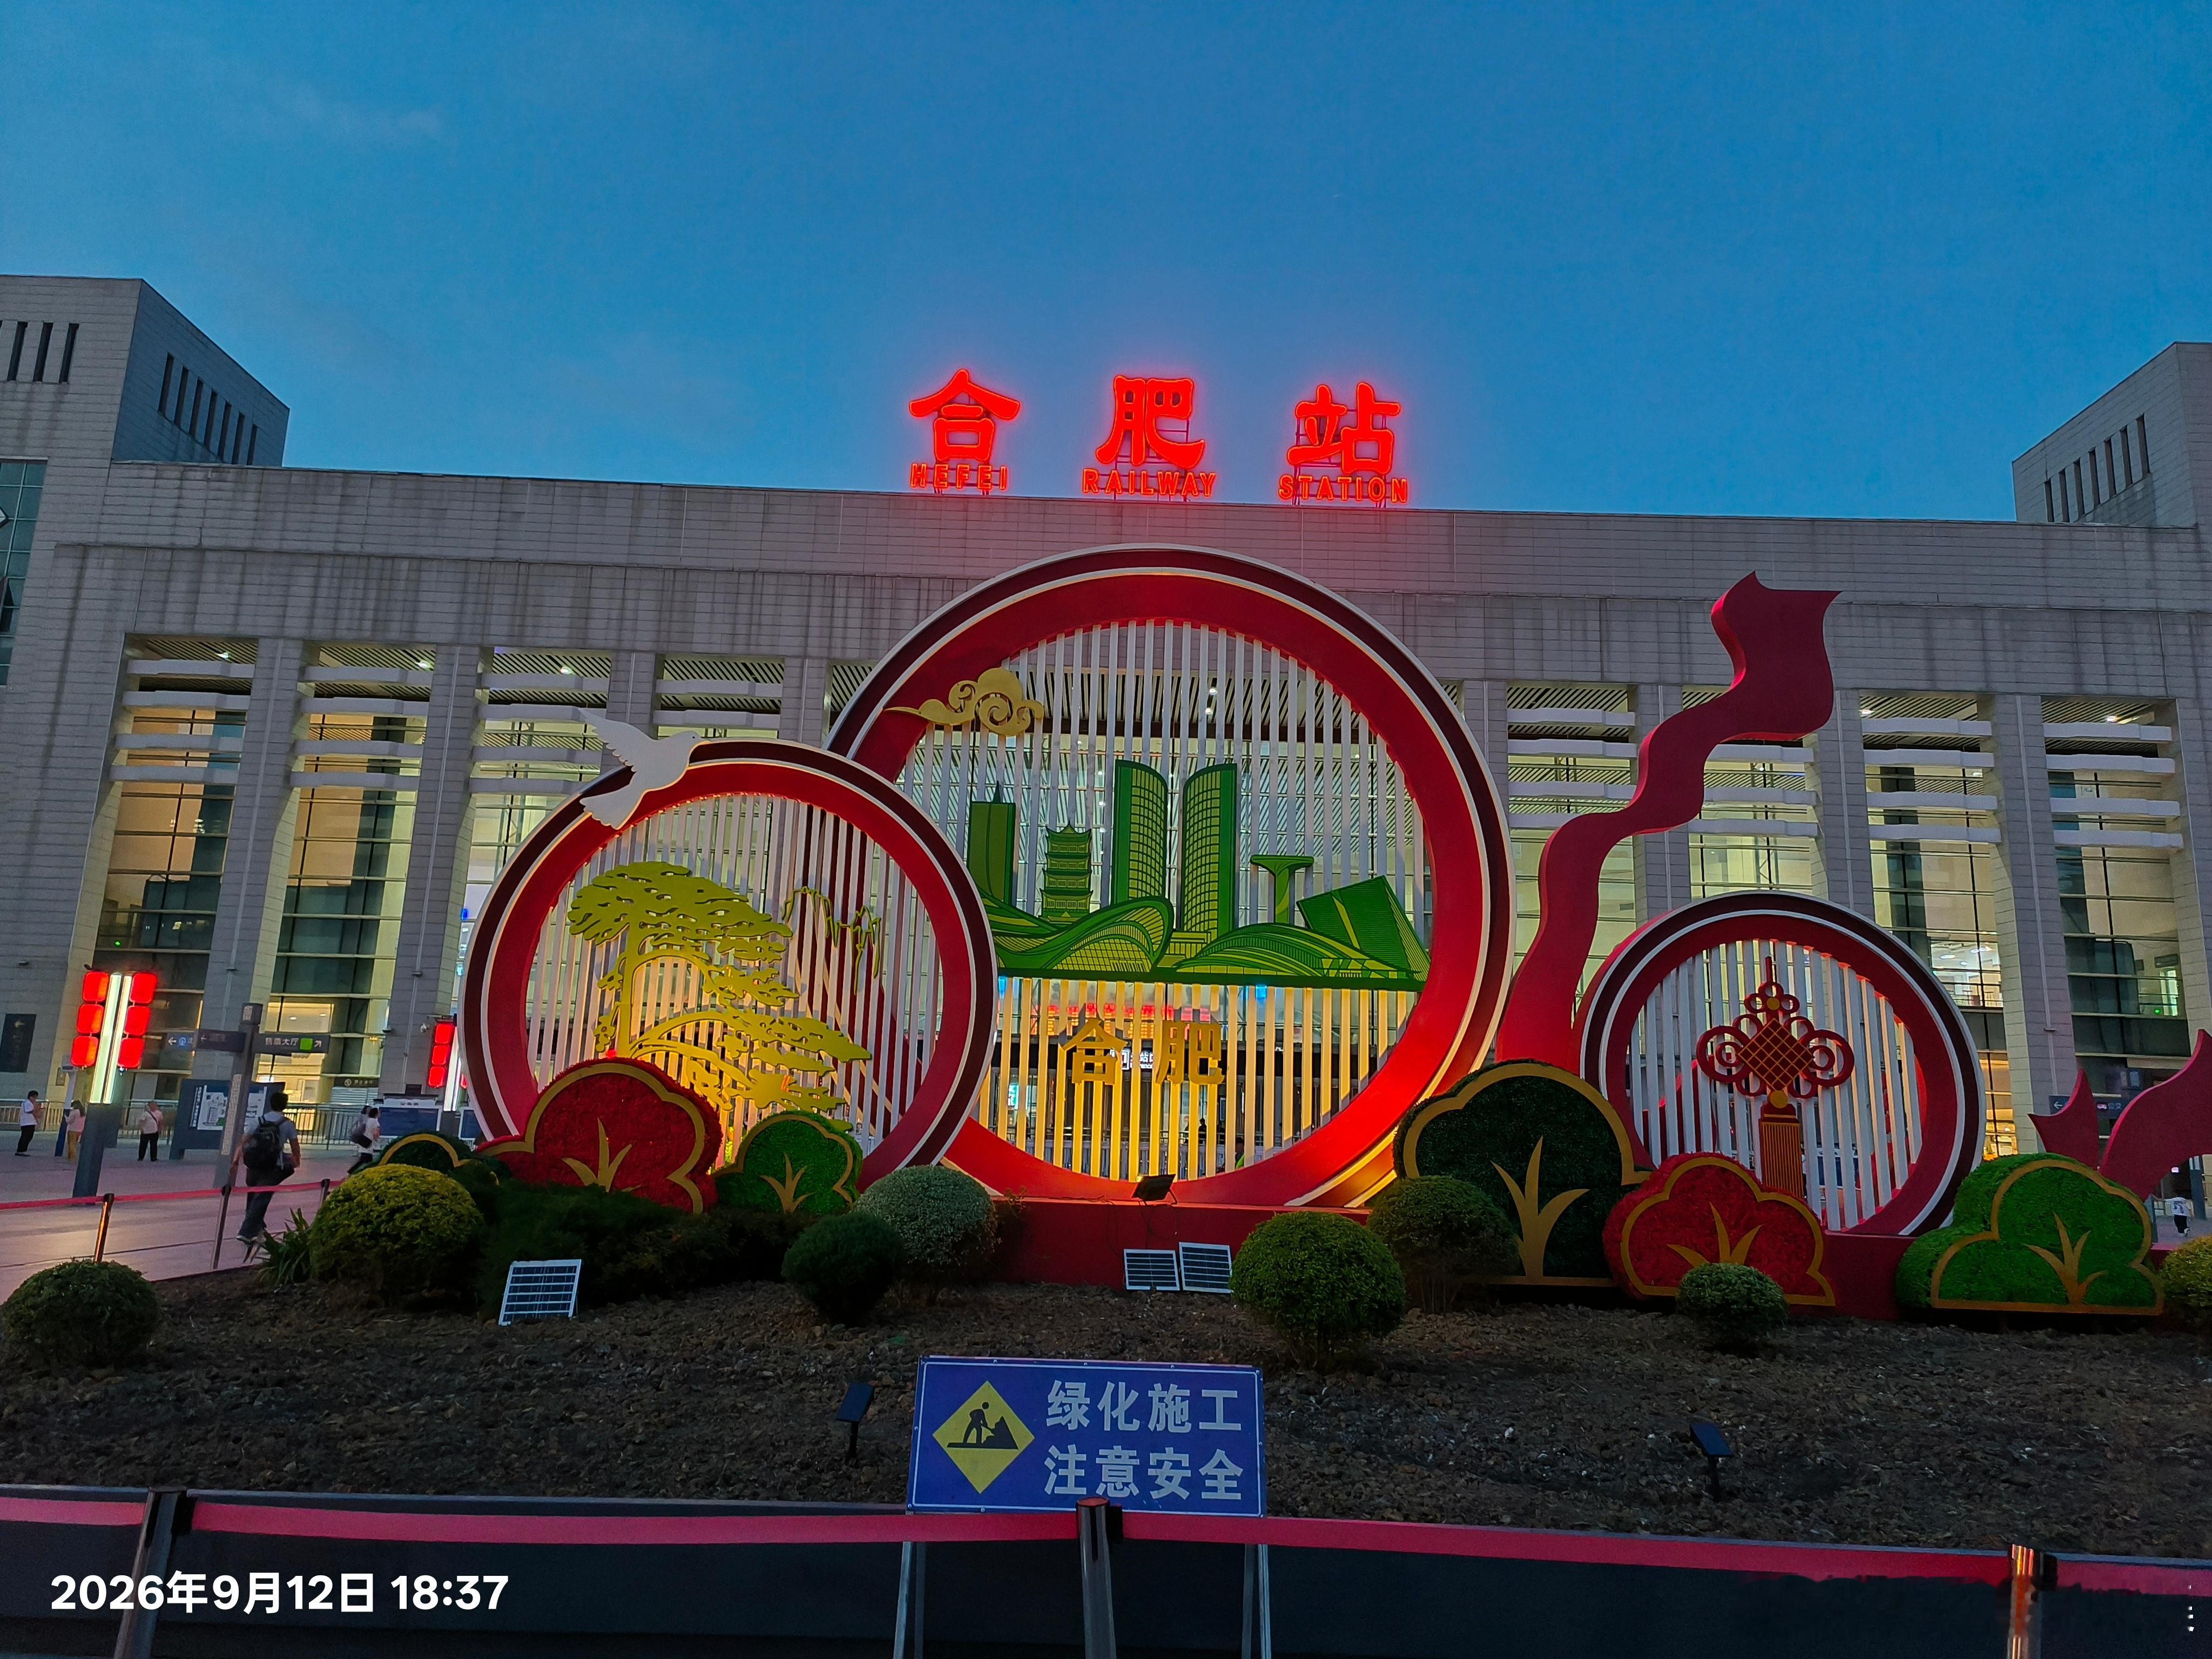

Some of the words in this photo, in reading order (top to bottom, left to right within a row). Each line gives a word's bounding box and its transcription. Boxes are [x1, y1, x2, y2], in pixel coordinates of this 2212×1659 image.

[909, 369, 1401, 474] 合肥站
[910, 462, 1007, 490] HEFEI
[1082, 468, 1216, 497] RAILWAY
[1278, 475, 1408, 503] STATION
[1058, 1018, 1224, 1085] 合肥
[1046, 1380, 1242, 1433] 绿化施工
[1043, 1444, 1243, 1500] 注意安全
